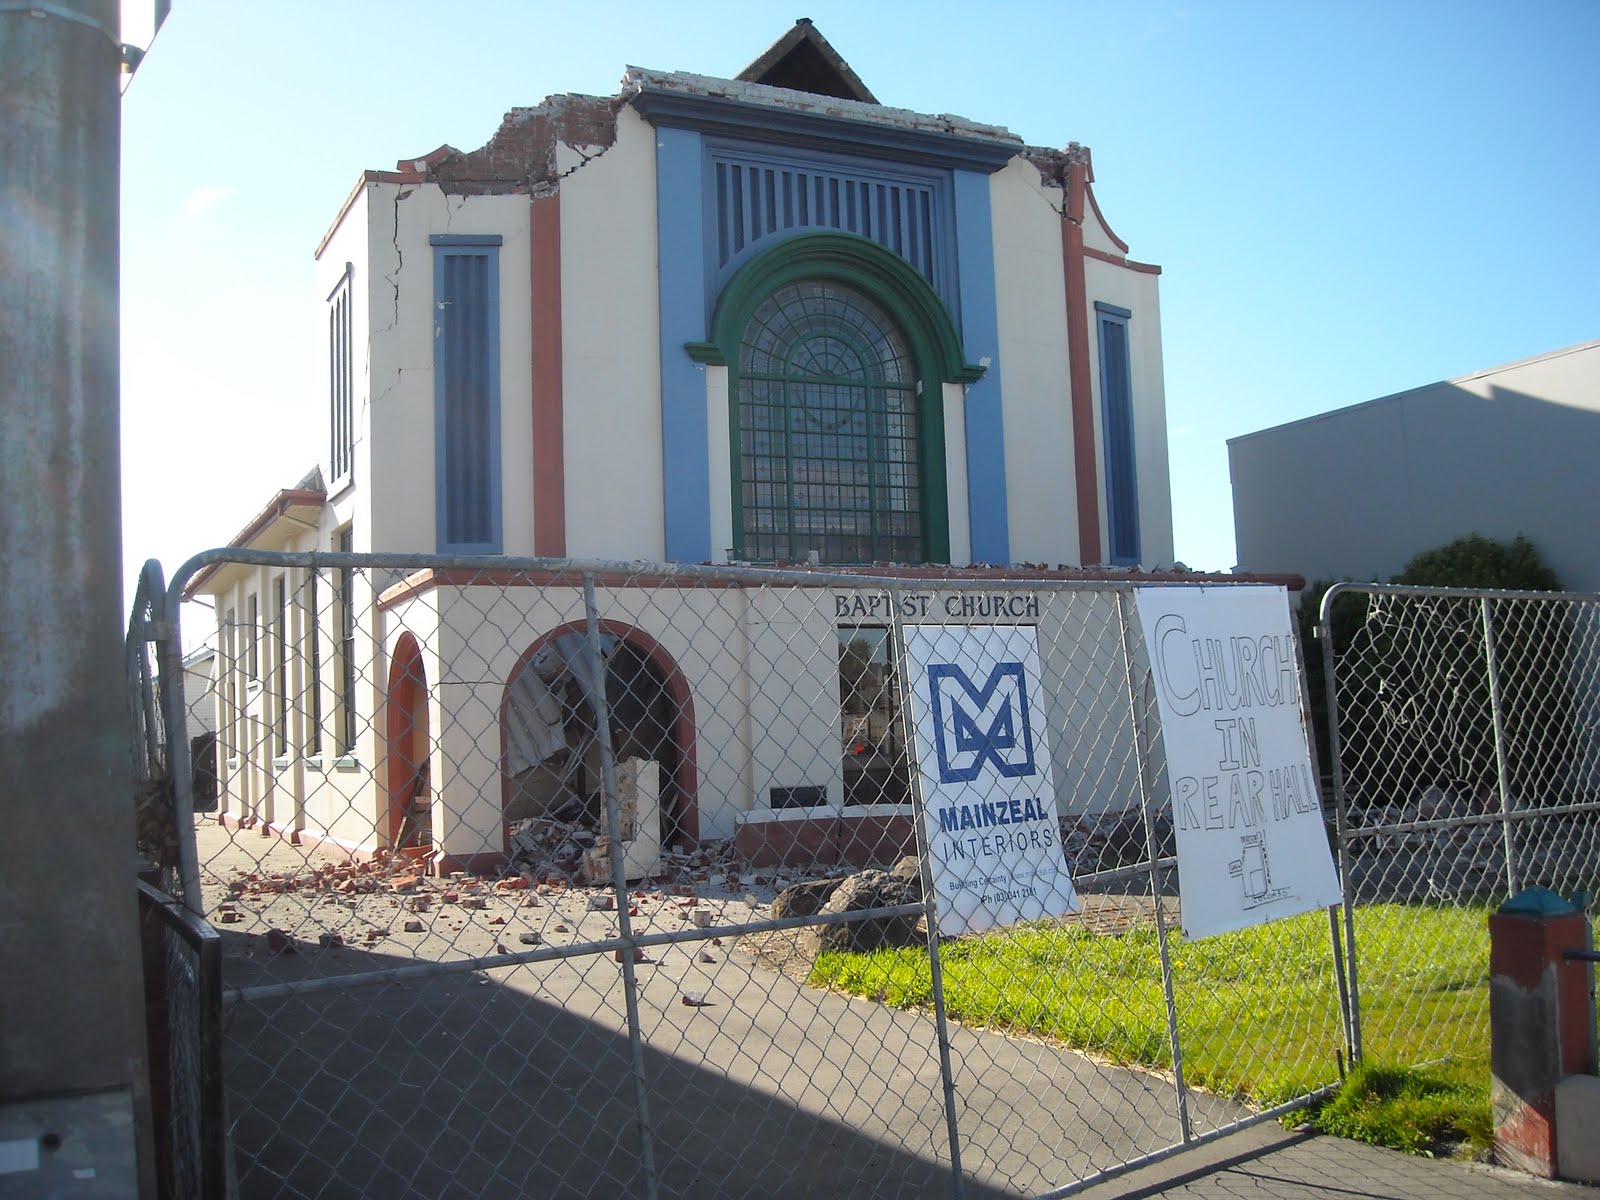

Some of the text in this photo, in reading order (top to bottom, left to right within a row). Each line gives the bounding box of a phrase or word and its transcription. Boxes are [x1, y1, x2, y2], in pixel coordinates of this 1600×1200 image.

[834, 596, 1040, 617] BAPTST CHURCH
[1155, 614, 1299, 717] CHURCH
[1215, 717, 1260, 771] IN
[939, 797, 1048, 832] MAINZEAL
[1176, 764, 1318, 830] REAR HALL
[943, 829, 1053, 862] INTERIORS
[982, 894, 993, 904] Ph
